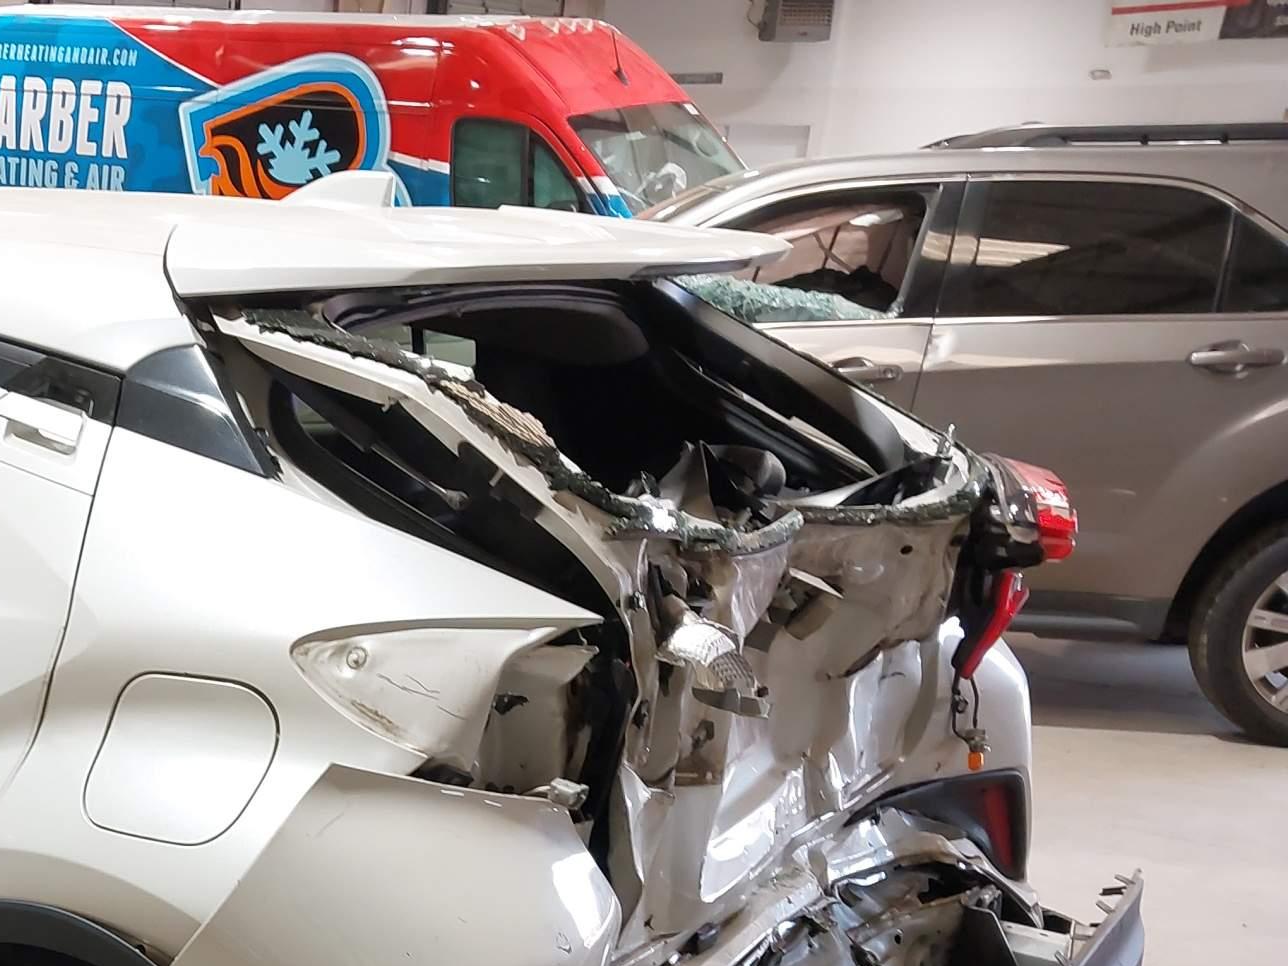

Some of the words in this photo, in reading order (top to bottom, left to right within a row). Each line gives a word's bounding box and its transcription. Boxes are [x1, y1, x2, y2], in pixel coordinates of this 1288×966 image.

[1129, 21, 1162, 38] High
[1165, 20, 1202, 34] Point
[64, 161, 80, 190] &
[86, 163, 126, 192] AIR
